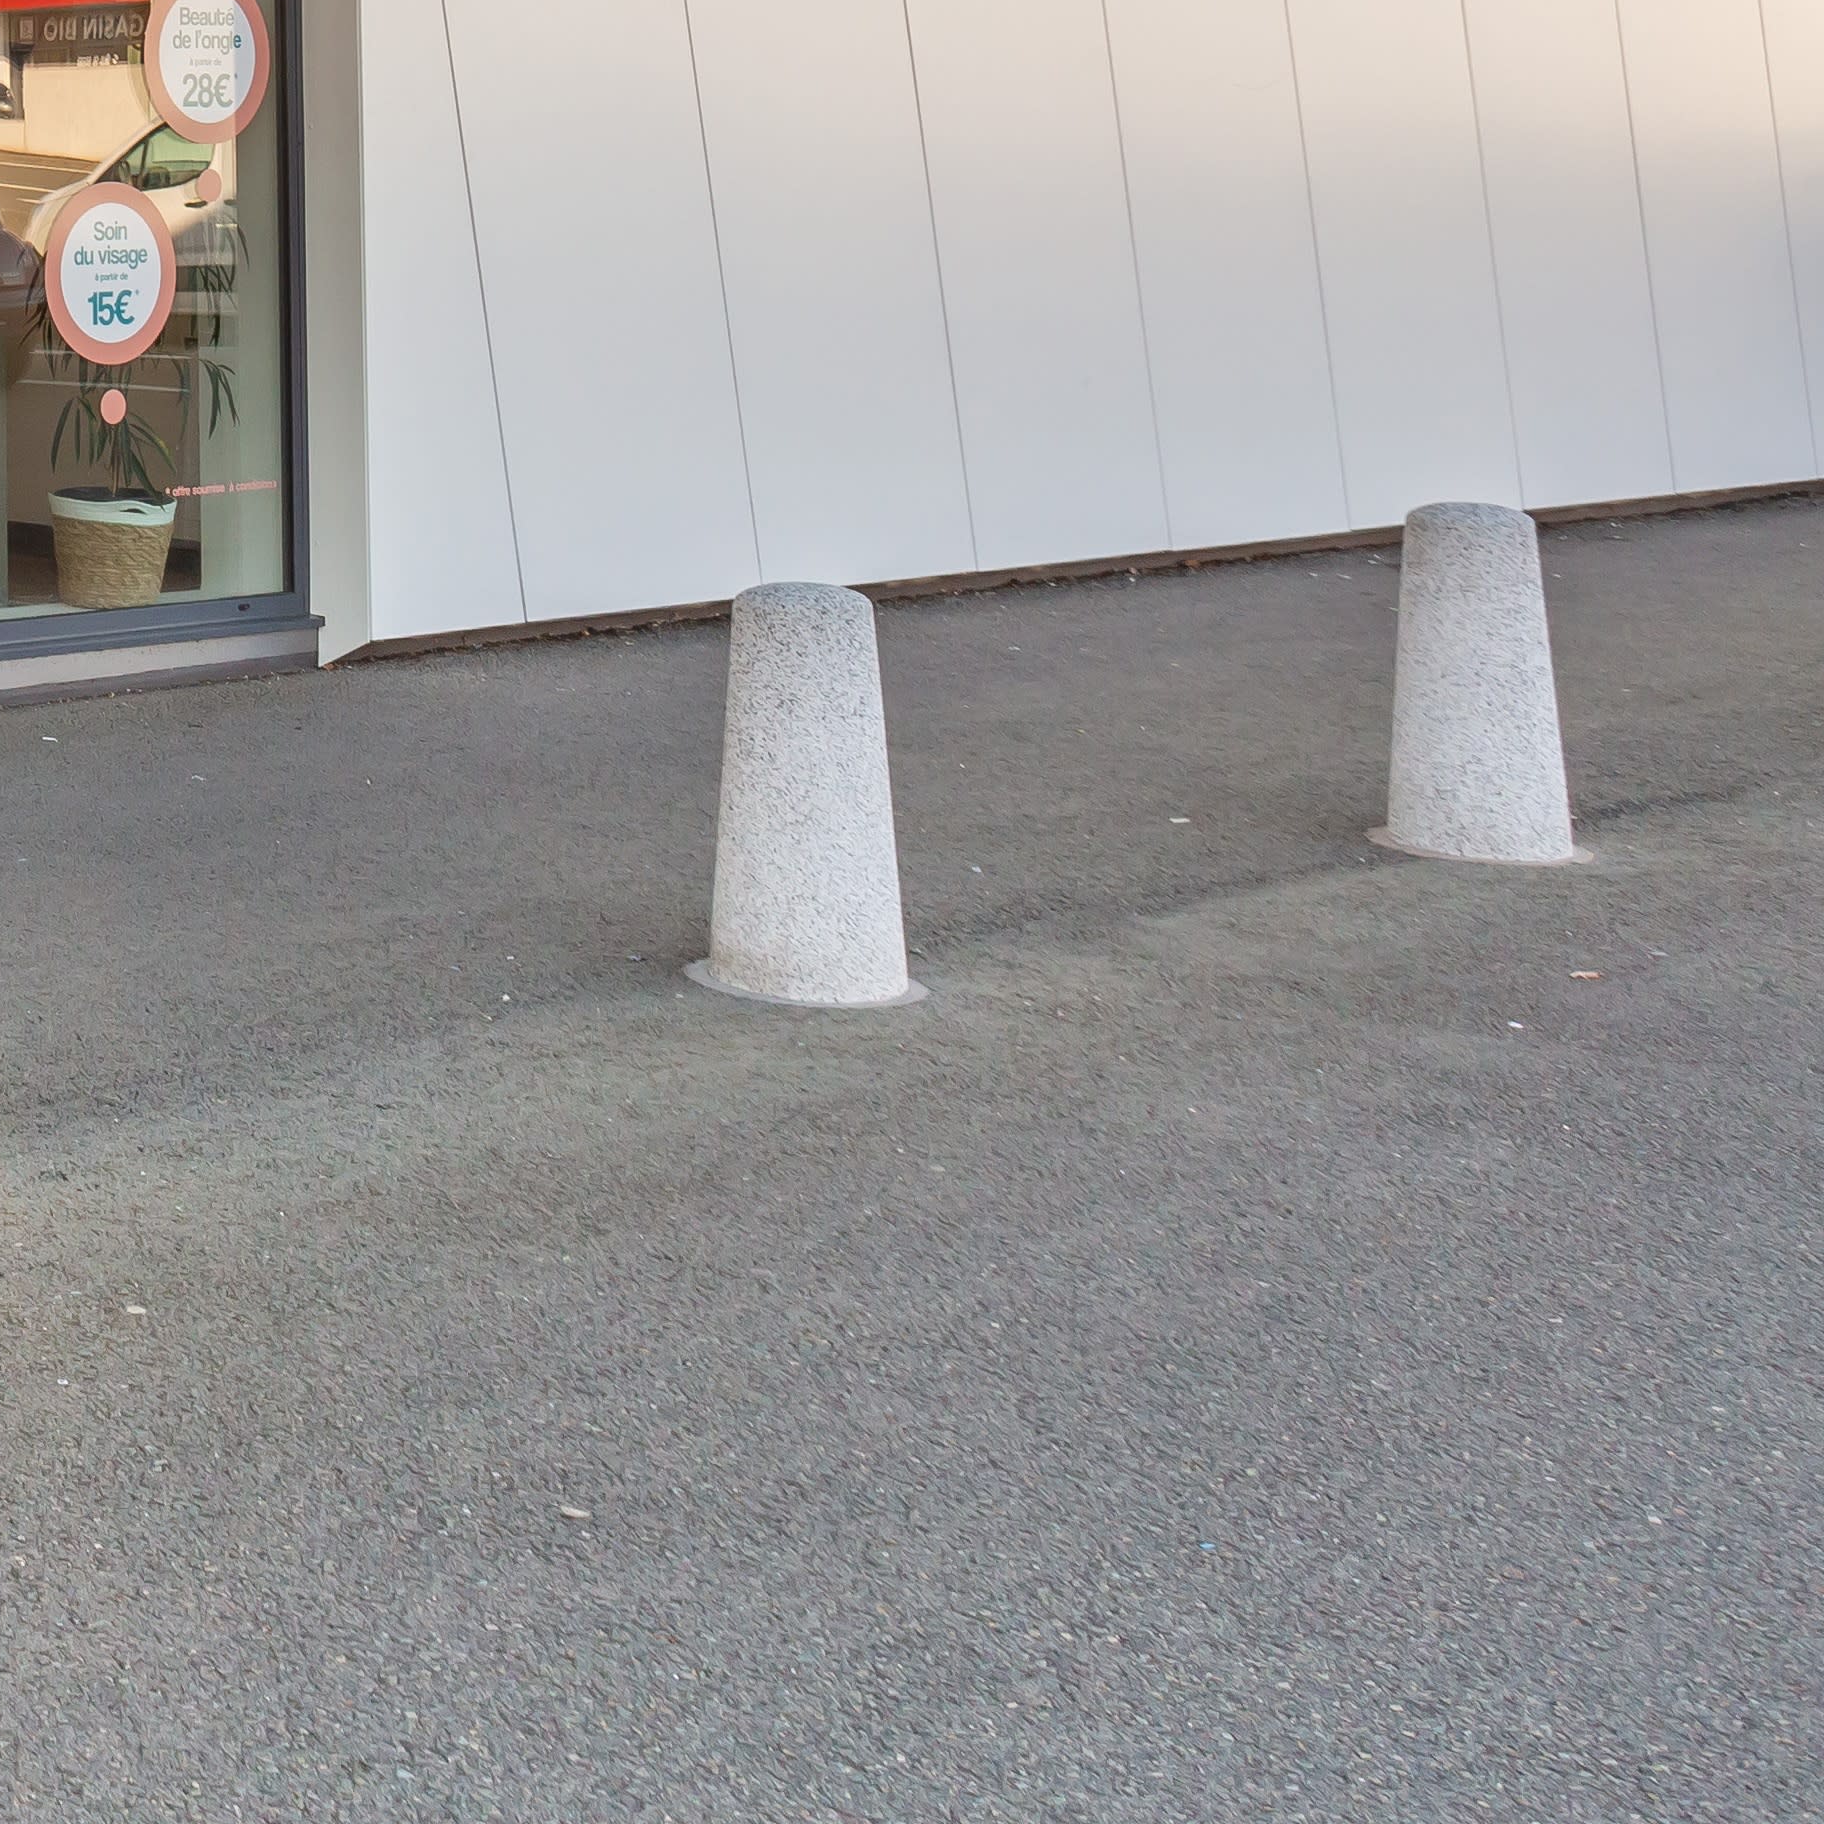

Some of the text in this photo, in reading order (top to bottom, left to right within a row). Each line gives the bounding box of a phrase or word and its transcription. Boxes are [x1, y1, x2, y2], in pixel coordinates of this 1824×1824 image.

[179, 6, 235, 27] Beauté
[172, 29, 242, 56] de l'ongle
[93, 220, 128, 241] Soin
[73, 245, 148, 270] du visage
[100, 273, 118, 283] partir
[119, 272, 129, 281] de
